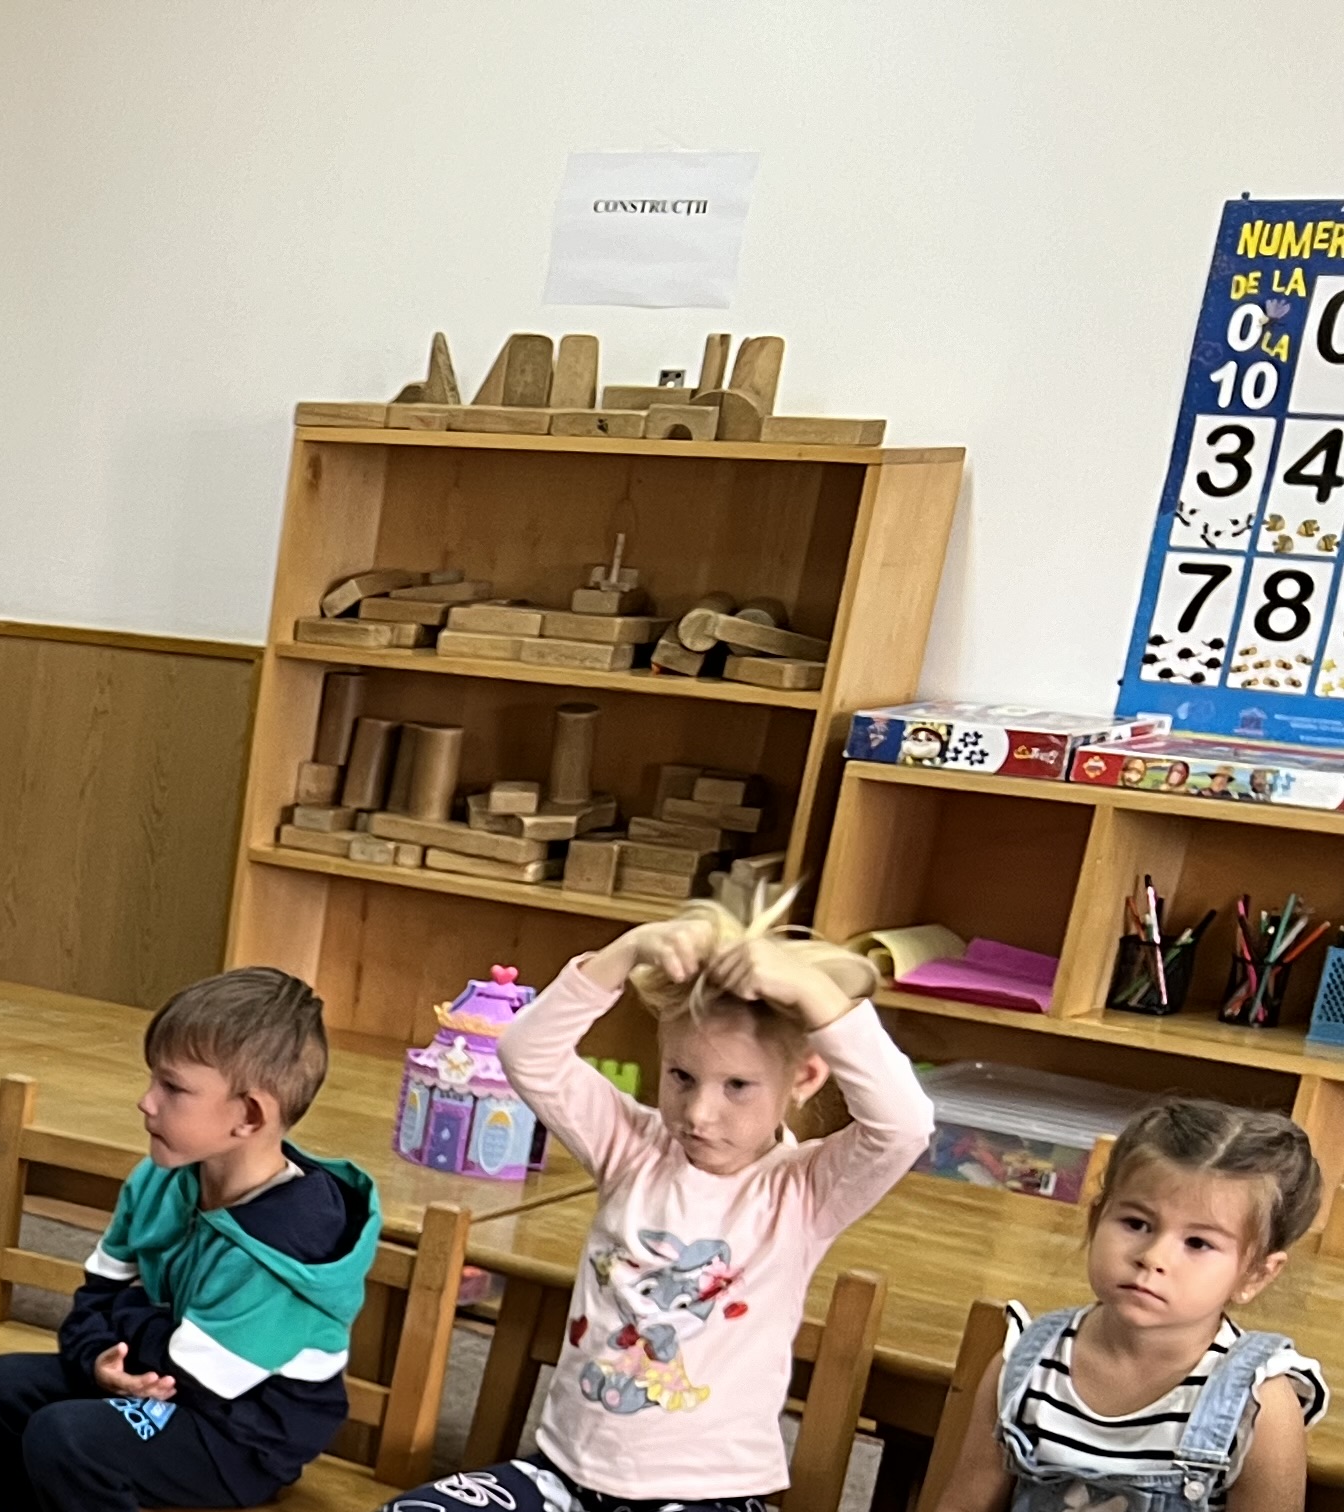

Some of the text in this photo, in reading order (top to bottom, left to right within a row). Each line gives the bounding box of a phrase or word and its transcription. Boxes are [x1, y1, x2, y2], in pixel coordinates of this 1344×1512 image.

[1230, 268, 1306, 300] DE LA
[1227, 303, 1263, 351] 0
[1262, 331, 1289, 362] LA
[1210, 361, 1278, 410] 10
[1197, 424, 1344, 503] 3 4
[1178, 563, 1314, 641] 7 8
